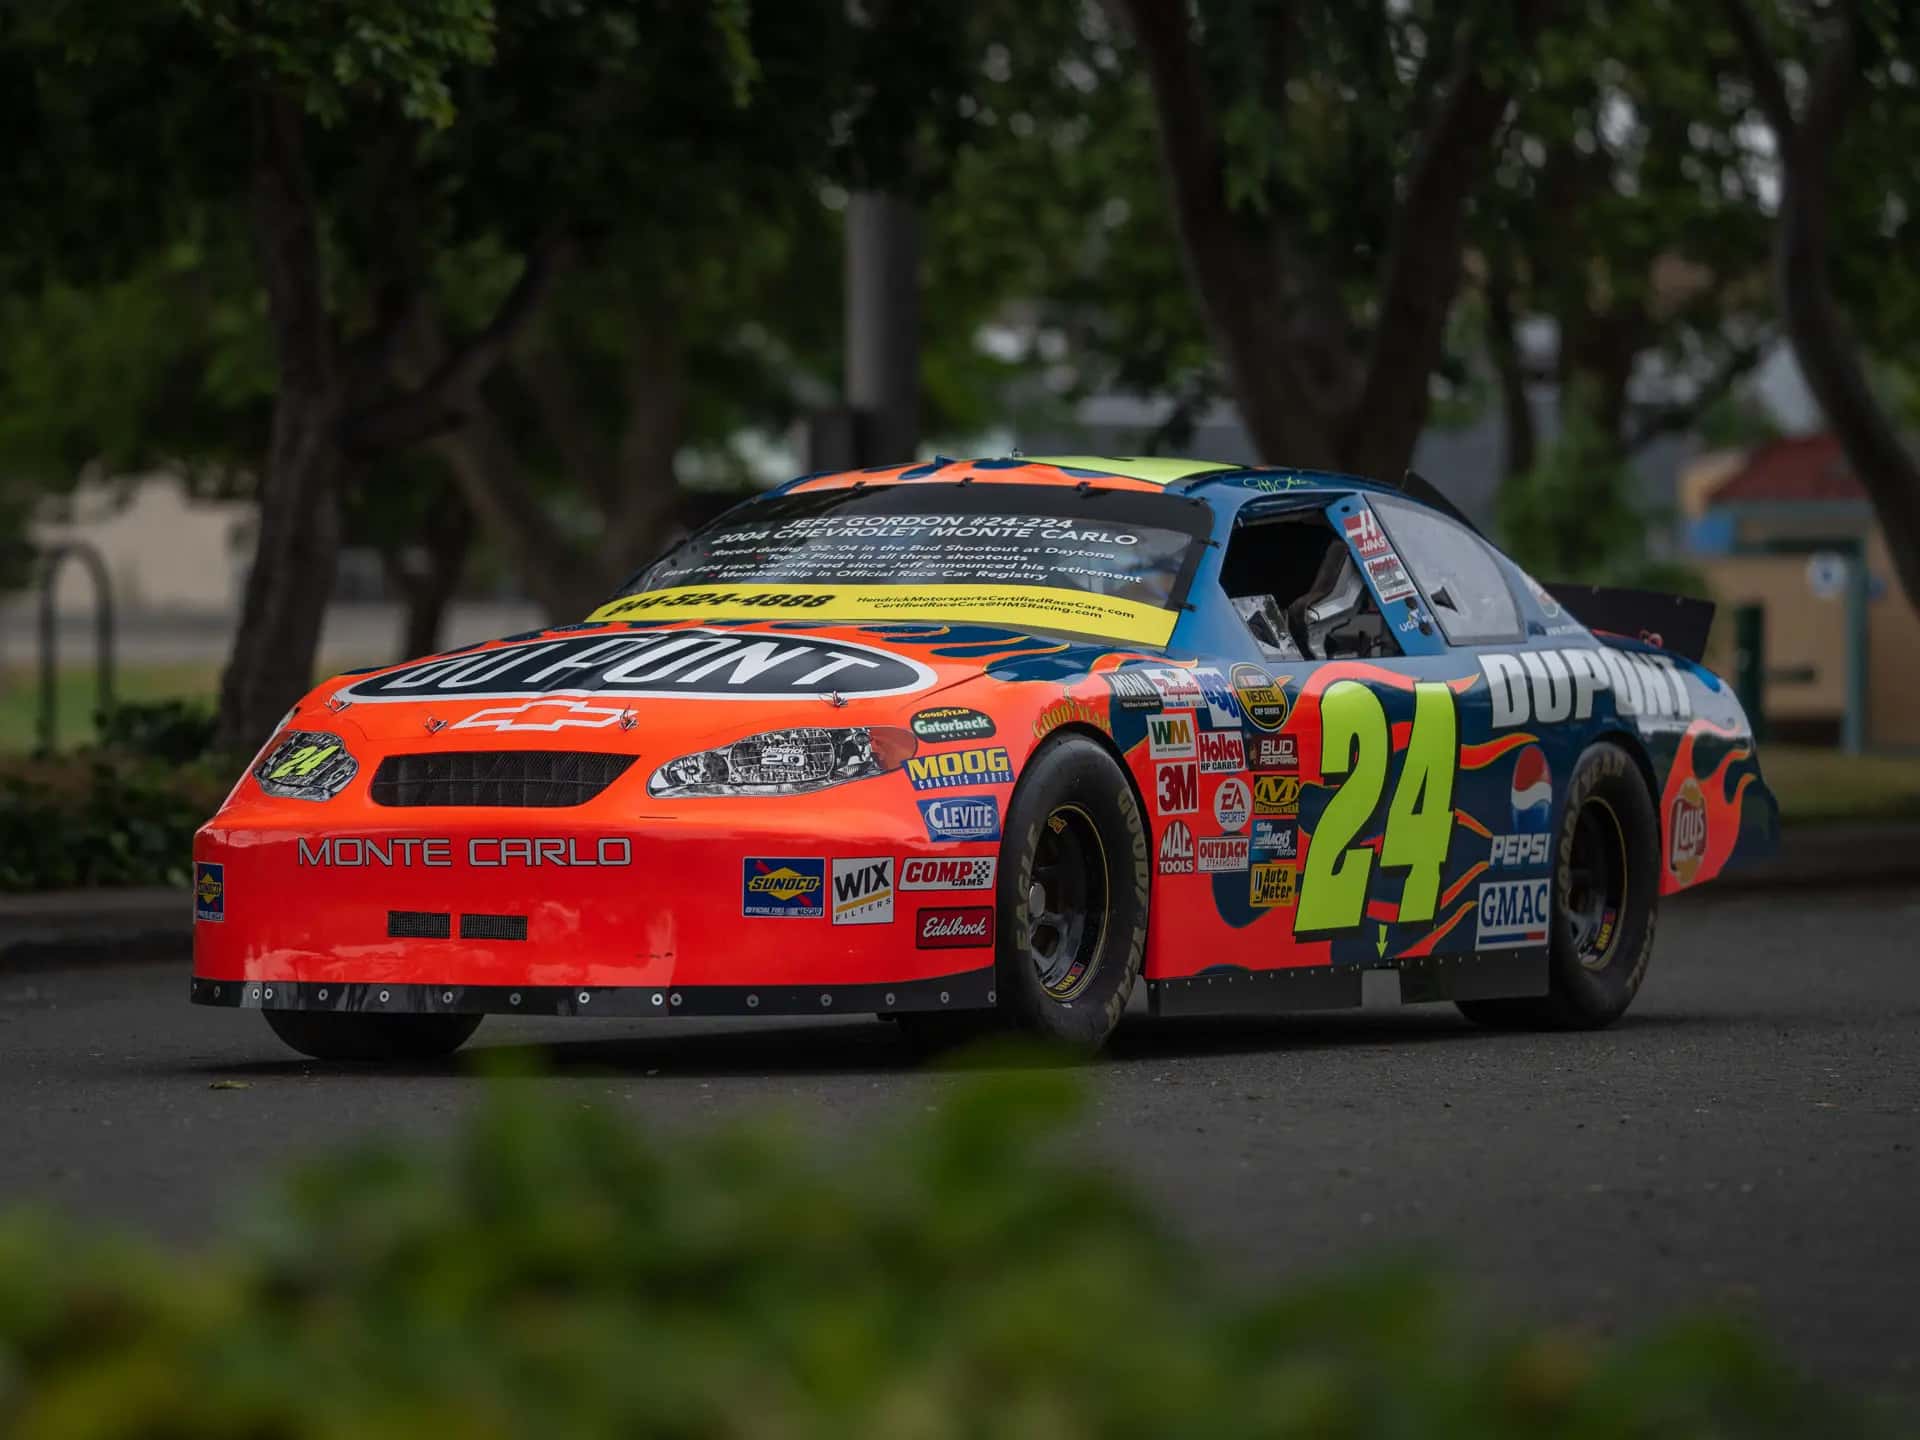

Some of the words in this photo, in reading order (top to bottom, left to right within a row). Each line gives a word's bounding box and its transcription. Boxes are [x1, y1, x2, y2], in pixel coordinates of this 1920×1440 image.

[782, 517, 843, 529] JEFF
[846, 515, 964, 527] GORDON
[970, 516, 1073, 529] #24-224
[711, 530, 771, 545] 2004
[773, 527, 926, 539] CHEVROLET
[929, 527, 1035, 539] MONTE
[1041, 528, 1138, 546] CARLO
[711, 546, 757, 557] Raced
[757, 544, 804, 553] during
[944, 544, 1021, 553] Shootout
[1044, 546, 1116, 560] Daytona
[768, 553, 793, 561] Top
[811, 552, 856, 560] Finish
[858, 552, 874, 560] in
[878, 552, 897, 560] all
[900, 552, 943, 560] three
[945, 553, 1029, 562] shootouts
[717, 570, 813, 579] Membership
[942, 570, 973, 578] Car
[975, 570, 1049, 581] Registry
[786, 561, 846, 569] offered
[890, 561, 926, 569] Jeff
[925, 562, 1018, 570] announced
[1021, 562, 1046, 571] his
[1049, 565, 1144, 585] retirement
[914, 715, 990, 735] Gatorback
[1150, 719, 1191, 745] WM
[761, 745, 806, 754] Hendrick
[1200, 734, 1244, 770] Holley
[1260, 740, 1294, 755] BUD
[268, 744, 341, 780] 24
[907, 747, 1010, 782] MOOG
[1200, 763, 1212, 771] HP
[1212, 761, 1237, 771] CARBS
[918, 775, 972, 790] CHASSIS
[976, 771, 1012, 784] PARTS
[1158, 763, 1198, 813] 3M
[1220, 783, 1245, 810] EA
[1293, 679, 1458, 933] 24
[928, 801, 993, 829] CLEVITE
[1219, 811, 1246, 824] SPORTS
[298, 837, 452, 866] MONTE
[467, 836, 632, 866] CARLO
[1200, 838, 1248, 859] OUTBACK
[1489, 832, 1551, 867] PEPSI
[905, 860, 974, 883] COMP
[1159, 859, 1195, 873] TOOLS
[1263, 868, 1289, 883] Auto
[751, 877, 819, 891] SUNOCO
[834, 860, 891, 903] WIX
[951, 877, 985, 887] CAMS
[1261, 883, 1293, 900] Meter
[834, 897, 893, 923] FILTERS
[1480, 882, 1549, 928] GMAC
[922, 916, 986, 938] Edelbrock
